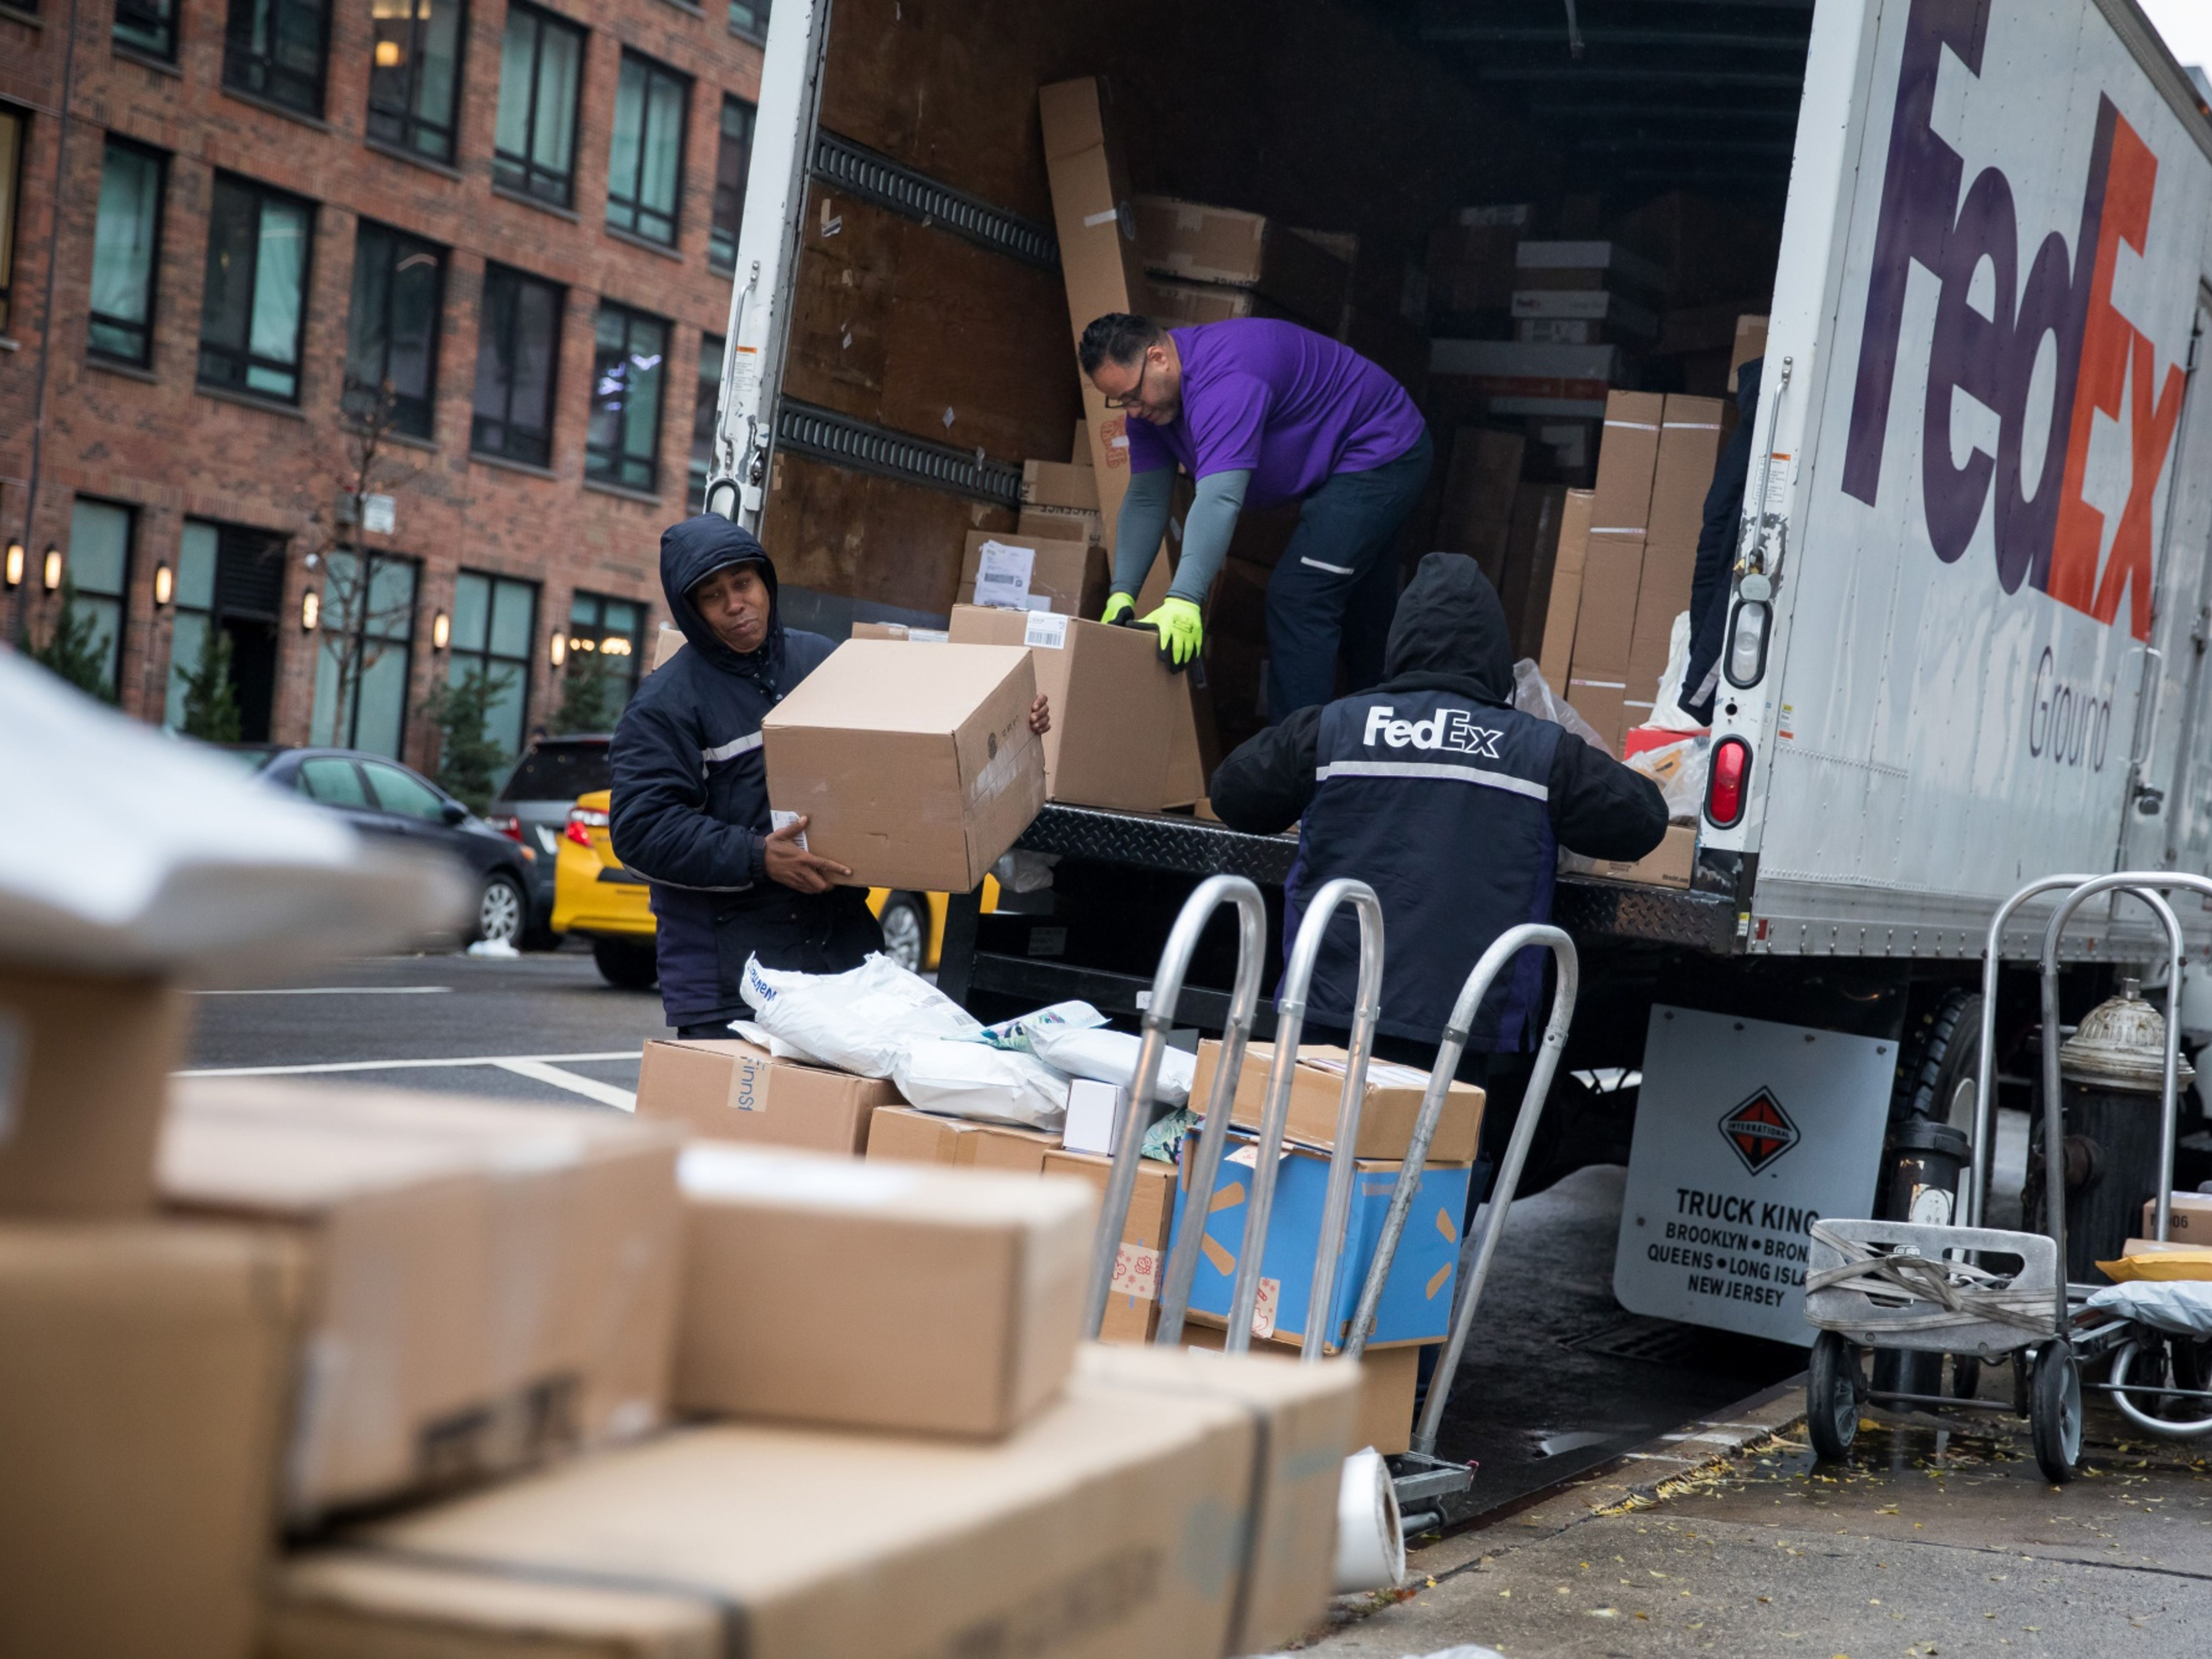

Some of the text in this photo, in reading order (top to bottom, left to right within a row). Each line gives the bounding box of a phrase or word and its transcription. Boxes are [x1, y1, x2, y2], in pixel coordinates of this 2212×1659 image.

[1841, 0, 2185, 643] FedEx
[2030, 646, 2116, 772] Ground
[1363, 706, 1504, 759] FedEx
[1728, 1122, 1790, 1139] INTERNATIONAL
[1677, 1188, 1755, 1225] TRUCK
[1666, 1223, 1810, 1263] BROOKLYN BRON
[1648, 1244, 1713, 1270] QUEENS
[1729, 1256, 1770, 1281] LONG
[1688, 1274, 1786, 1308] NEW JERSEY
